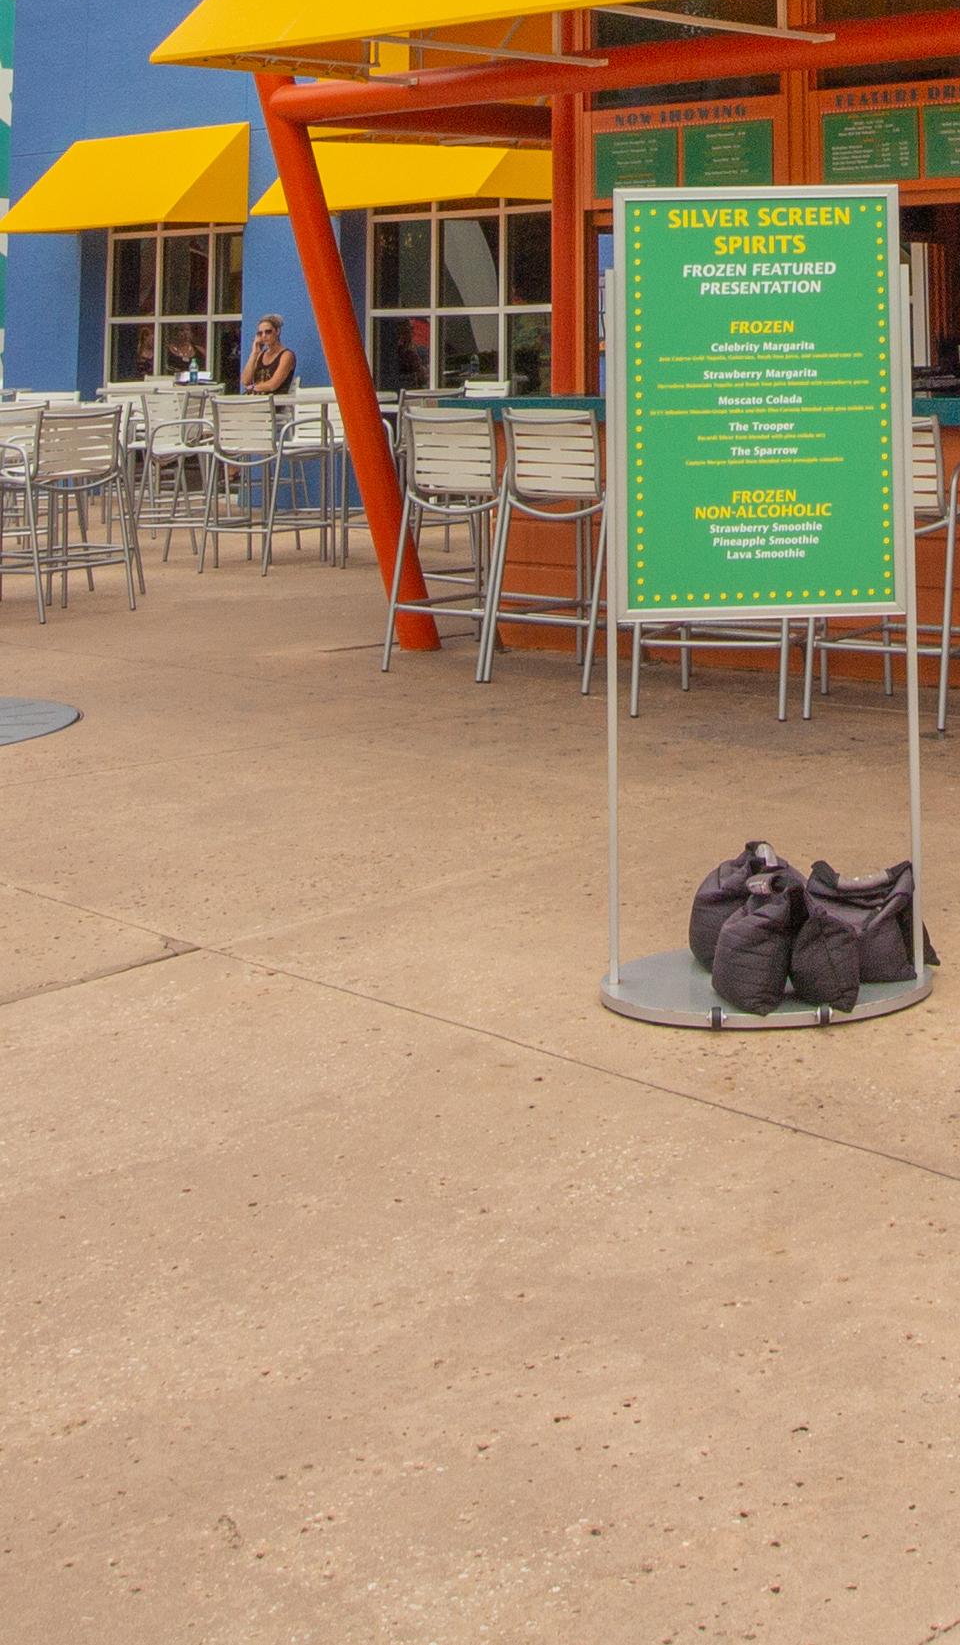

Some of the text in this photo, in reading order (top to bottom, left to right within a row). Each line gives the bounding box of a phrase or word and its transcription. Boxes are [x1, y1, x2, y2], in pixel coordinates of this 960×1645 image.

[667, 206, 851, 229] SILVER SCREEN
[714, 234, 807, 255] SPIRITS
[683, 261, 837, 278] FROZEN FEATURED
[700, 280, 822, 295] PRESENTATION
[729, 320, 795, 334] FROZEN
[711, 340, 815, 353] Celebrity Margarita
[703, 368, 818, 381] Strawberry Margarita
[718, 394, 803, 406] Moscato Colada
[728, 421, 795, 433] The Trooper
[730, 445, 799, 458] The Sparrow
[731, 489, 797, 504] FROZEN
[694, 502, 833, 520] NON-ALCOHOLIC
[709, 521, 823, 534] Strawberry Smoothie
[712, 534, 820, 548] Pineapple Smoothie
[726, 547, 806, 560] Lava Smoothie
